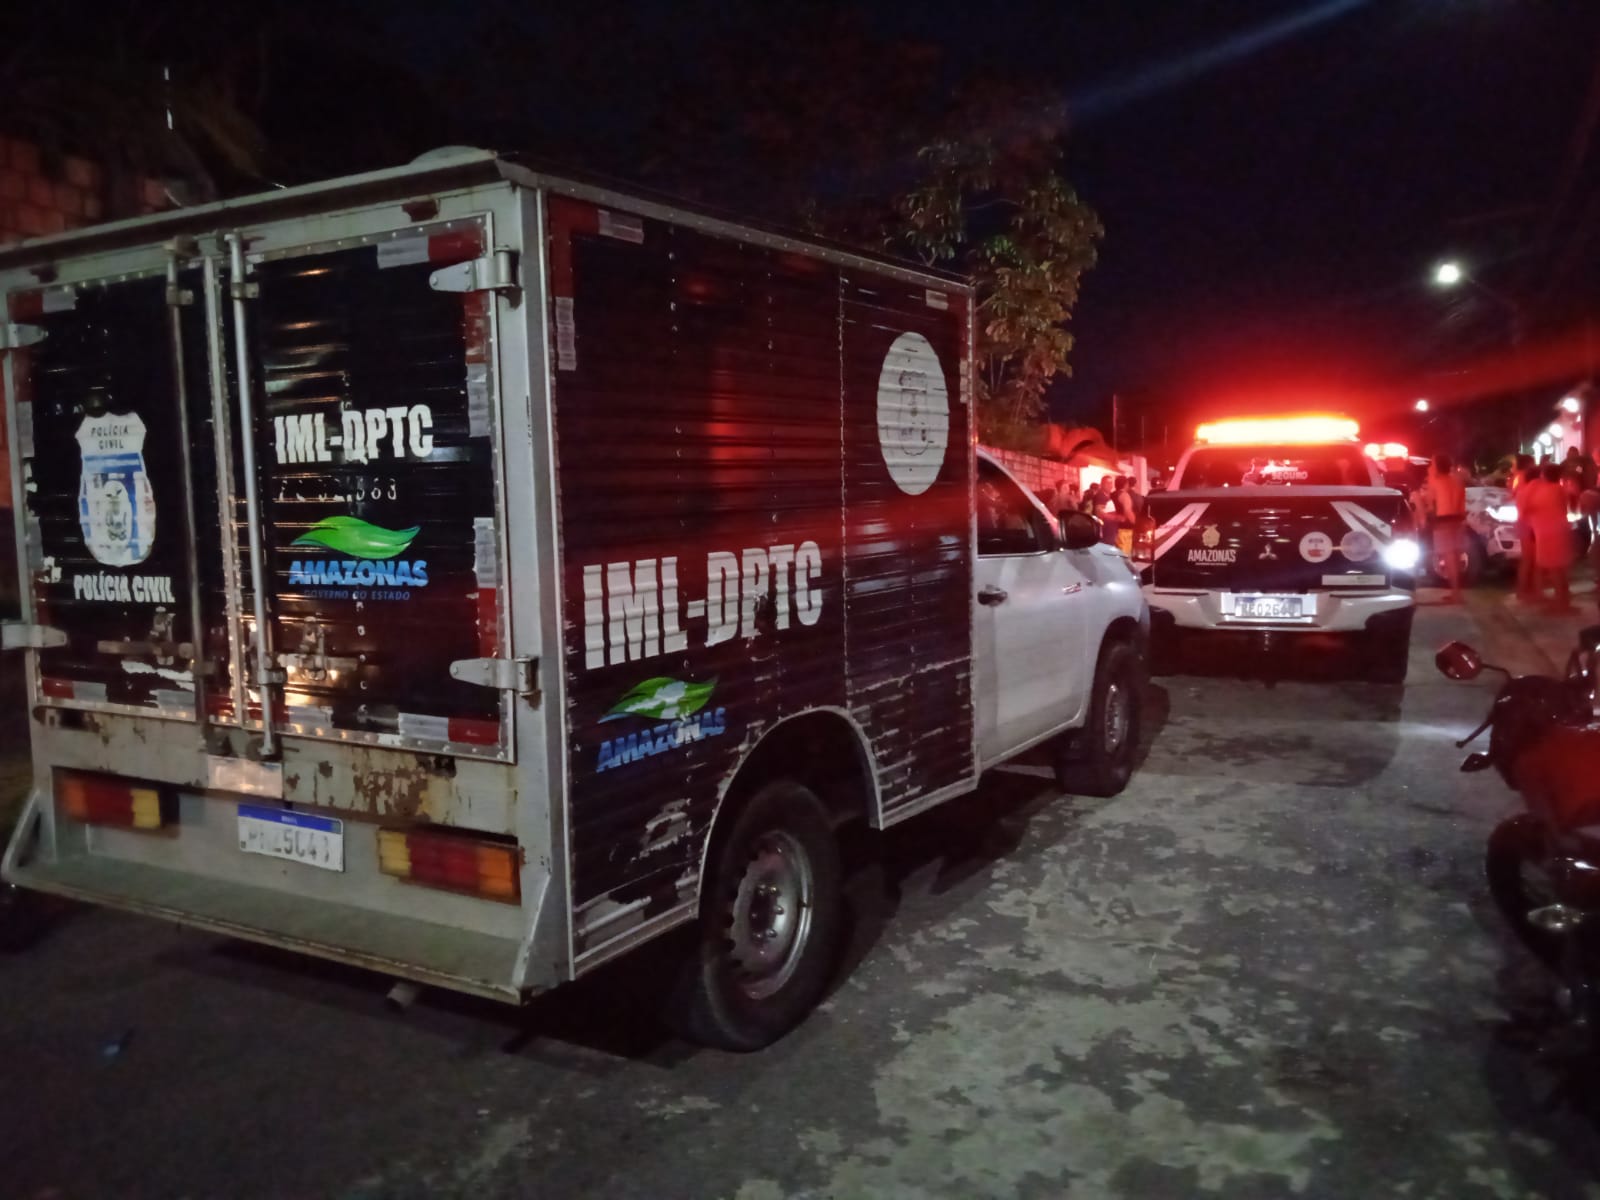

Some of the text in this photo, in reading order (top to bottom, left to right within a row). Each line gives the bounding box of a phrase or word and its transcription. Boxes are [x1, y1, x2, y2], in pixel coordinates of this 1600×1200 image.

[98, 439, 124, 450] CIVIL
[274, 404, 433, 465] IML-DPTC
[1187, 549, 1237, 563] AMAZONAS
[73, 571, 176, 603] POLÍCIA CIVIL
[288, 560, 429, 587] AMAZONAS
[371, 591, 411, 600] ESTADO
[583, 540, 823, 670] IML-DPTC
[596, 706, 727, 774] AMAZONAS
